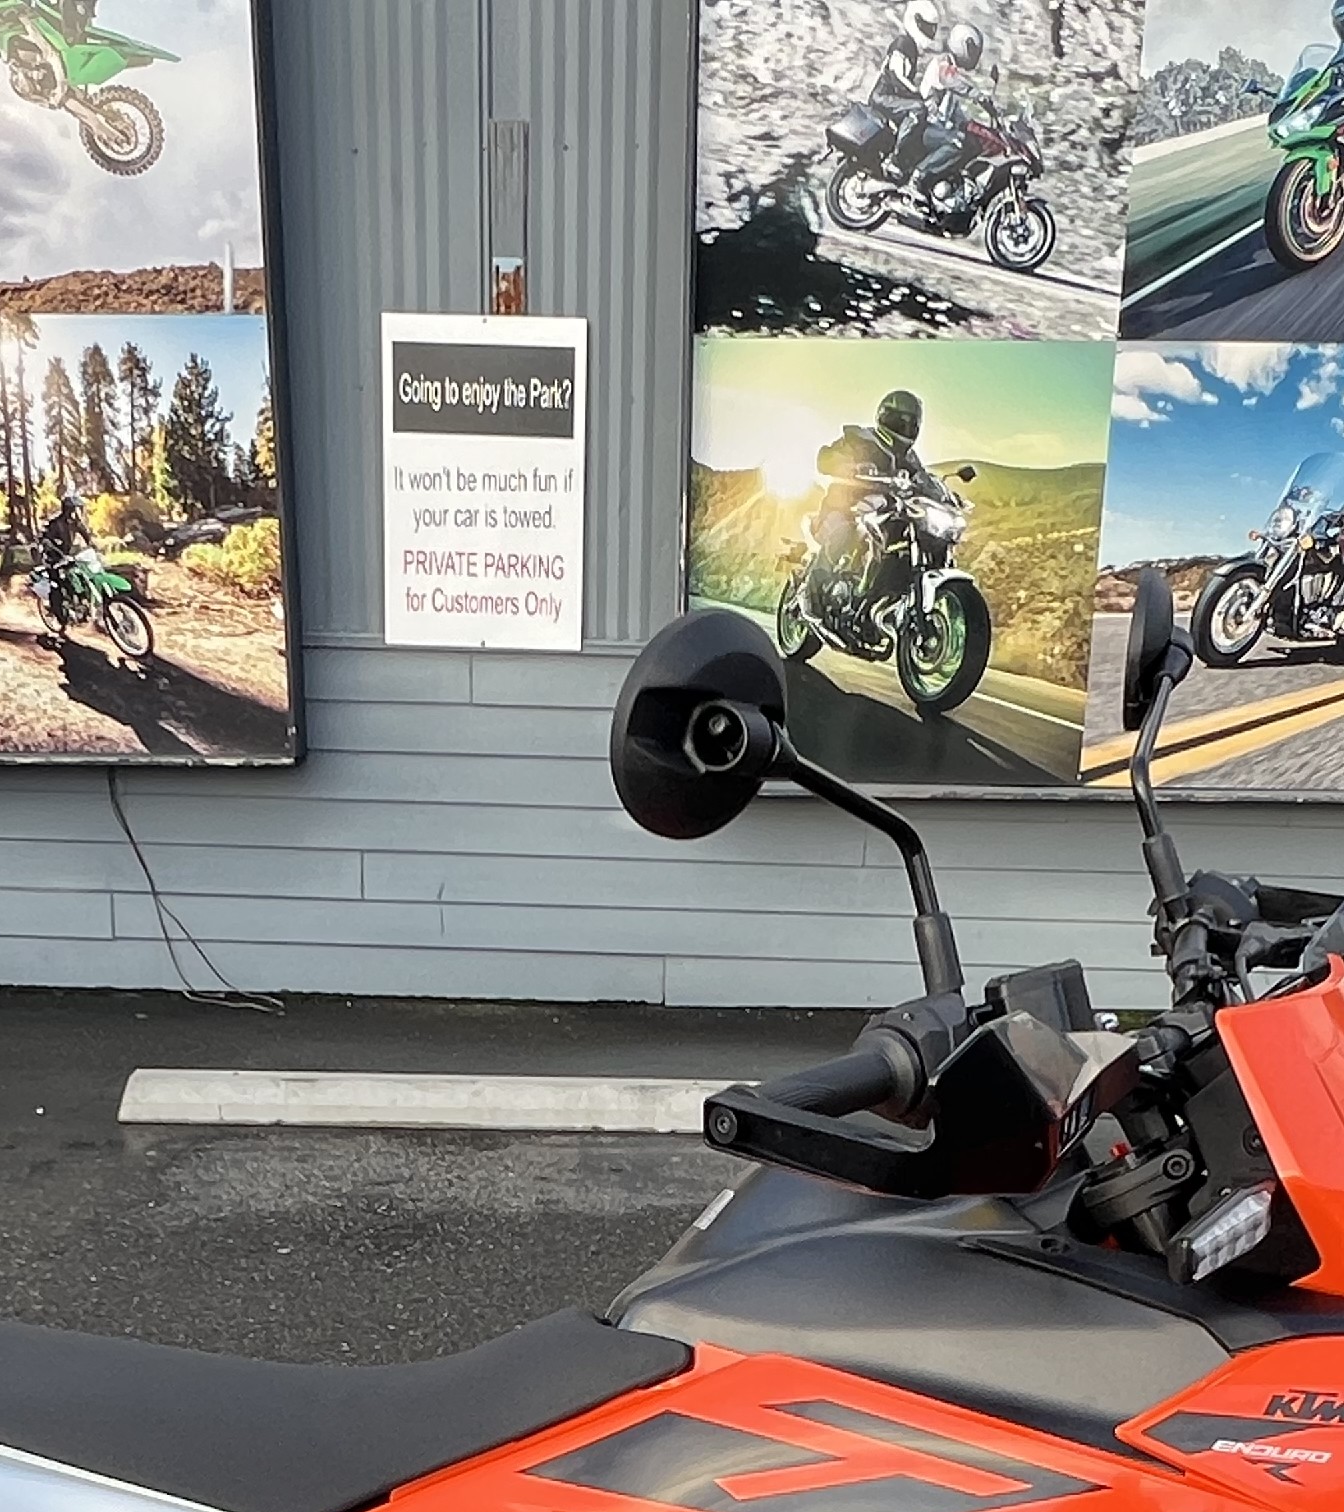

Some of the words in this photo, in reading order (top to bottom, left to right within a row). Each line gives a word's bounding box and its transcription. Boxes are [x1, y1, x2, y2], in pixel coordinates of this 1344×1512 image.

[399, 372, 442, 412] Going
[445, 376, 459, 406] to
[462, 376, 501, 414] enjoy
[504, 377, 526, 408] the
[529, 377, 572, 409] Park?
[394, 465, 404, 492] It
[408, 465, 452, 492] won't
[456, 466, 477, 492] be
[482, 467, 527, 492] much
[532, 466, 558, 492] fun
[563, 467, 574, 493] if
[412, 508, 449, 534] your
[453, 508, 480, 528] car
[484, 503, 498, 528] is
[503, 503, 556, 530] towed.
[403, 549, 478, 578] PRIVATE
[484, 552, 564, 580] PARKING
[405, 586, 427, 612] for
[432, 587, 520, 616] Customers
[524, 591, 562, 624] Only
[1211, 1440, 1332, 1464] ENDURO
